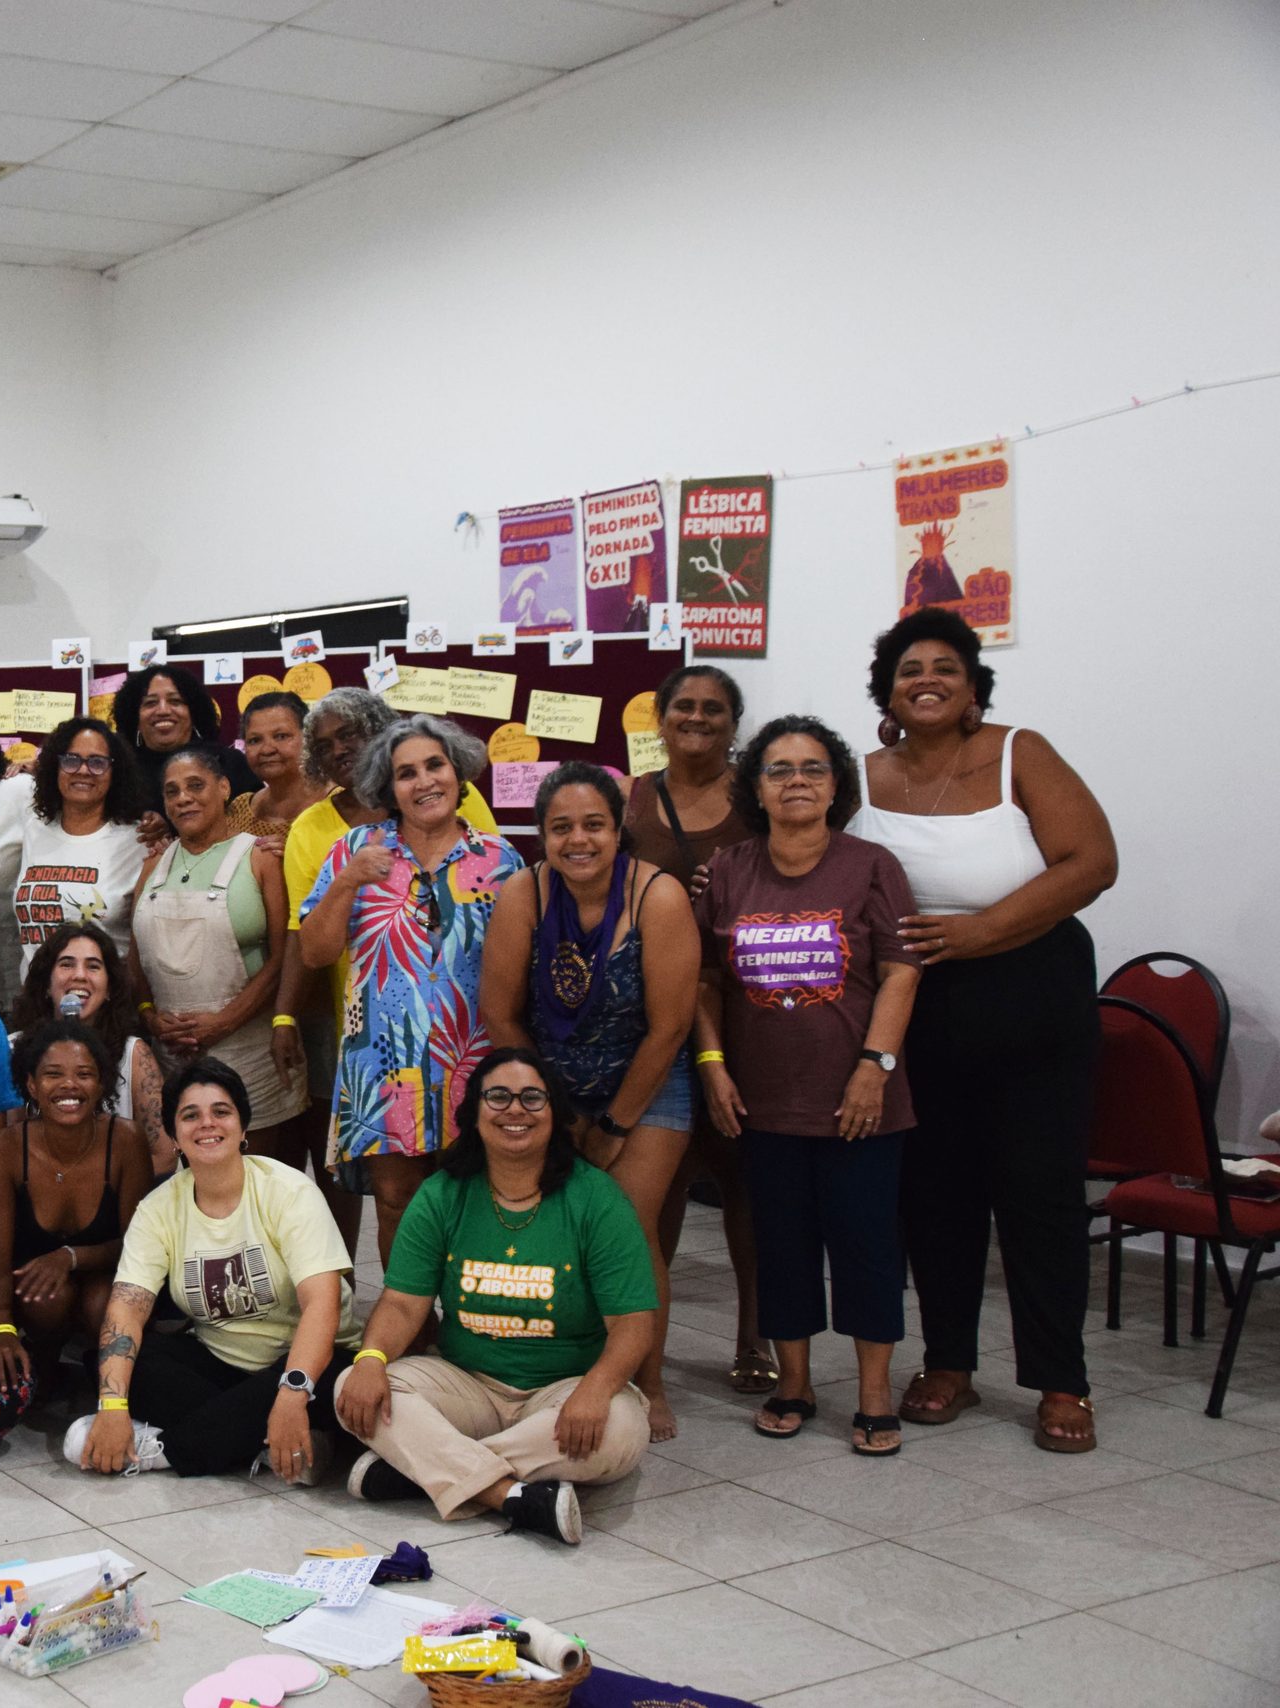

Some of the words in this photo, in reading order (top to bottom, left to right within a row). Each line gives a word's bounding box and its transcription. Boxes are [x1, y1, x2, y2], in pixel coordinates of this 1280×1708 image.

[899, 464, 1005, 499] MULHERES
[588, 489, 657, 515] FEMINISTAS
[688, 490, 762, 514] LÉSBICA
[899, 496, 957, 521] TRANS
[588, 520, 617, 536] PELO
[620, 517, 640, 530] FIM
[642, 512, 659, 526] DA
[683, 515, 766, 536] FEMINISTA
[589, 535, 650, 558] JORNADA
[590, 561, 627, 584] 6X1!
[969, 572, 1008, 598] SÃO
[682, 606, 763, 625] SAPATONA
[687, 627, 763, 646] ONVICTA
[24, 866, 98, 884] DEMOCRACIA
[31, 904, 64, 923] CASA
[736, 925, 833, 946] NEGRA
[737, 951, 836, 967] FEMINISTA
[463, 1259, 555, 1281] LEGALIZAR
[460, 1276, 477, 1293] O
[477, 1279, 554, 1300] ABORTO
[458, 1310, 525, 1331] DIREITO
[526, 1318, 555, 1332] AO
